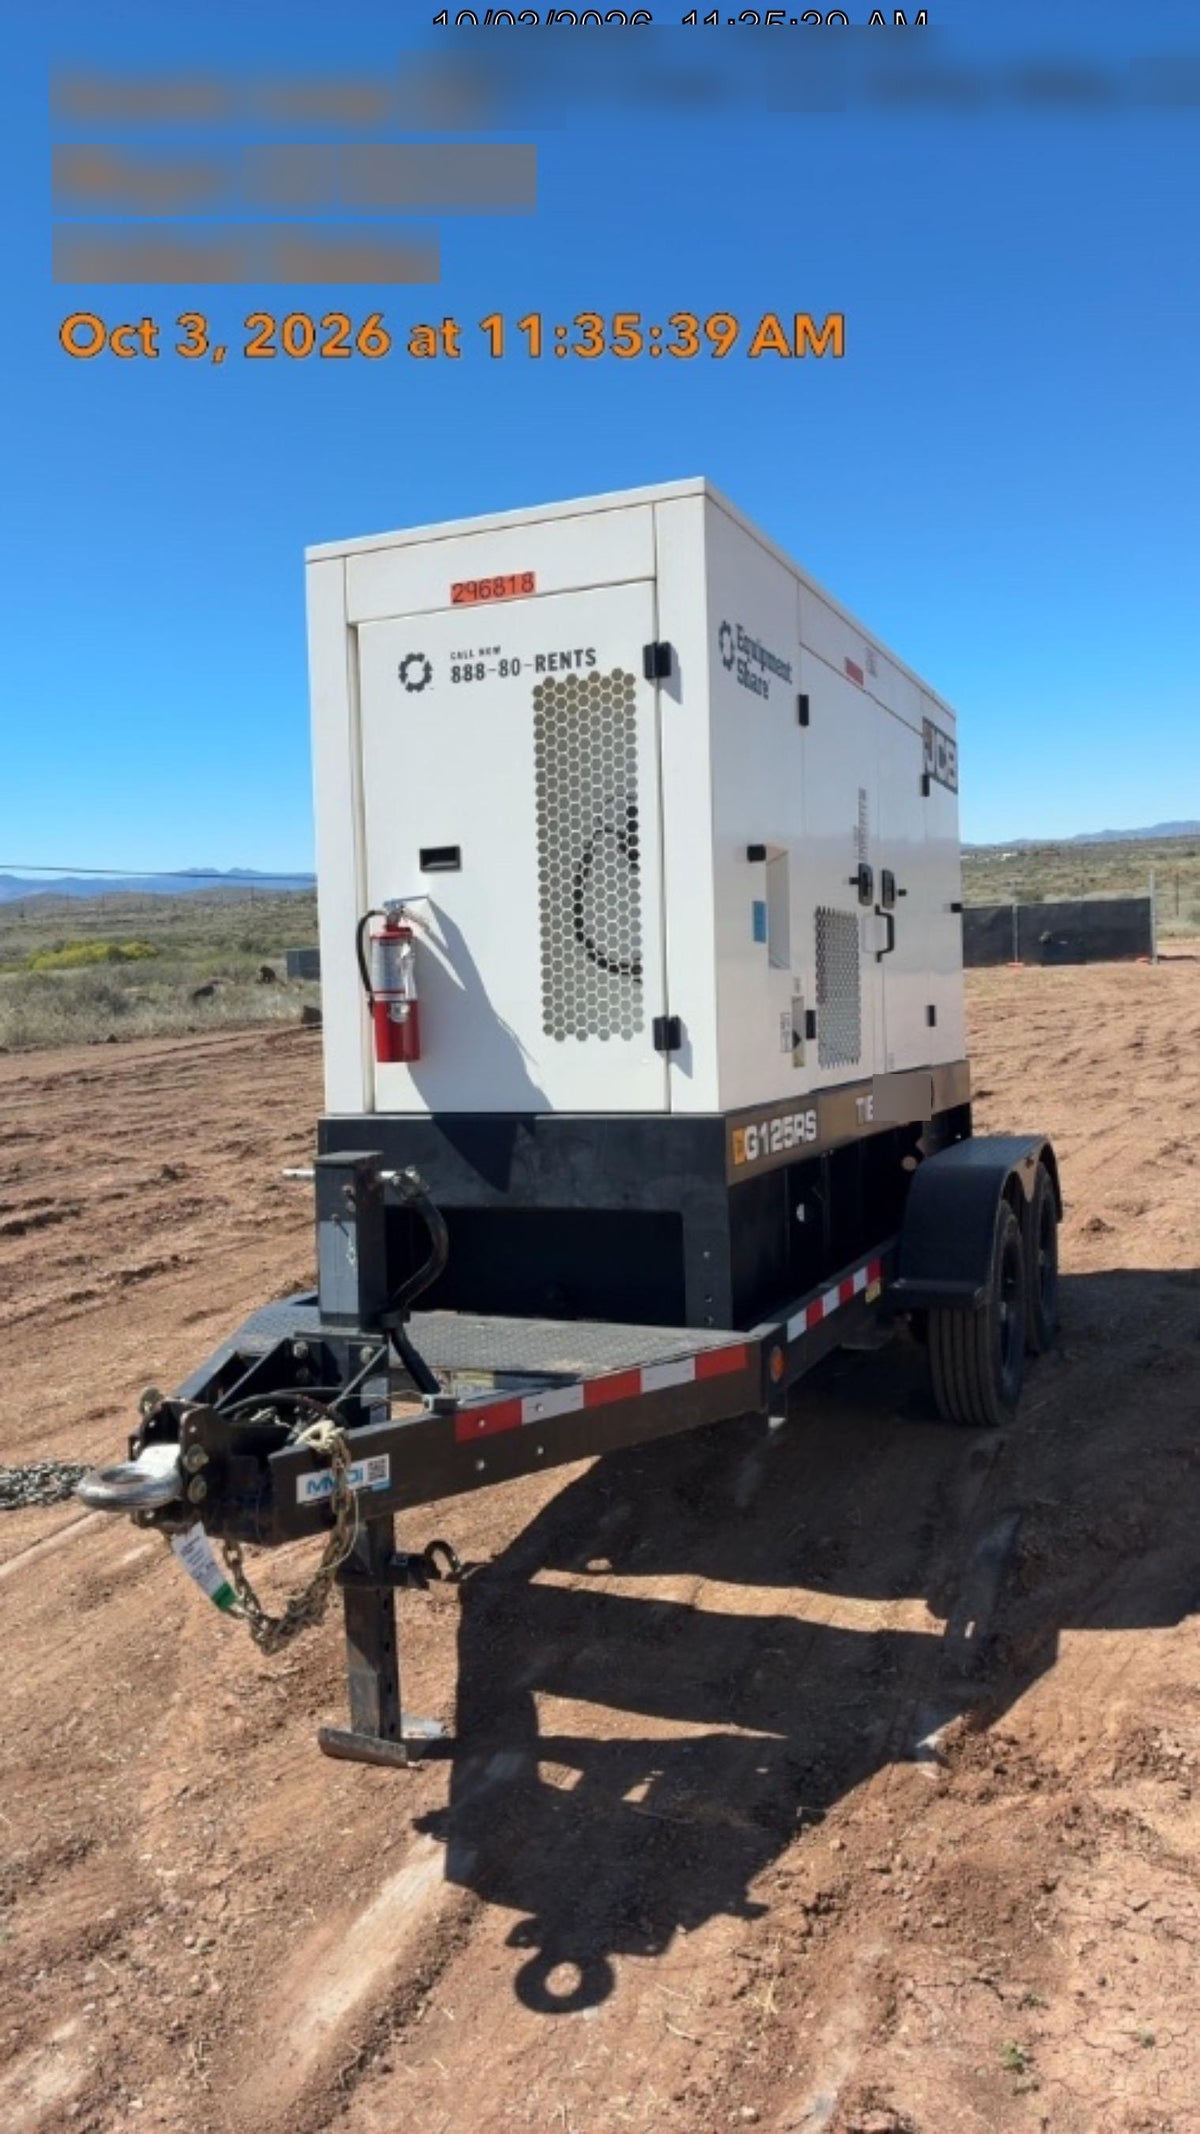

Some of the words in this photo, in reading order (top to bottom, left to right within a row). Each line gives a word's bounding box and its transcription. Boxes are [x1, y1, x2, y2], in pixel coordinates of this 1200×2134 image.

[452, 571, 535, 603] 296818
[450, 649, 475, 660] CALL
[450, 647, 597, 684] 888-80-RENTS
[736, 623, 793, 685] Equipment
[737, 656, 769, 700] Share
